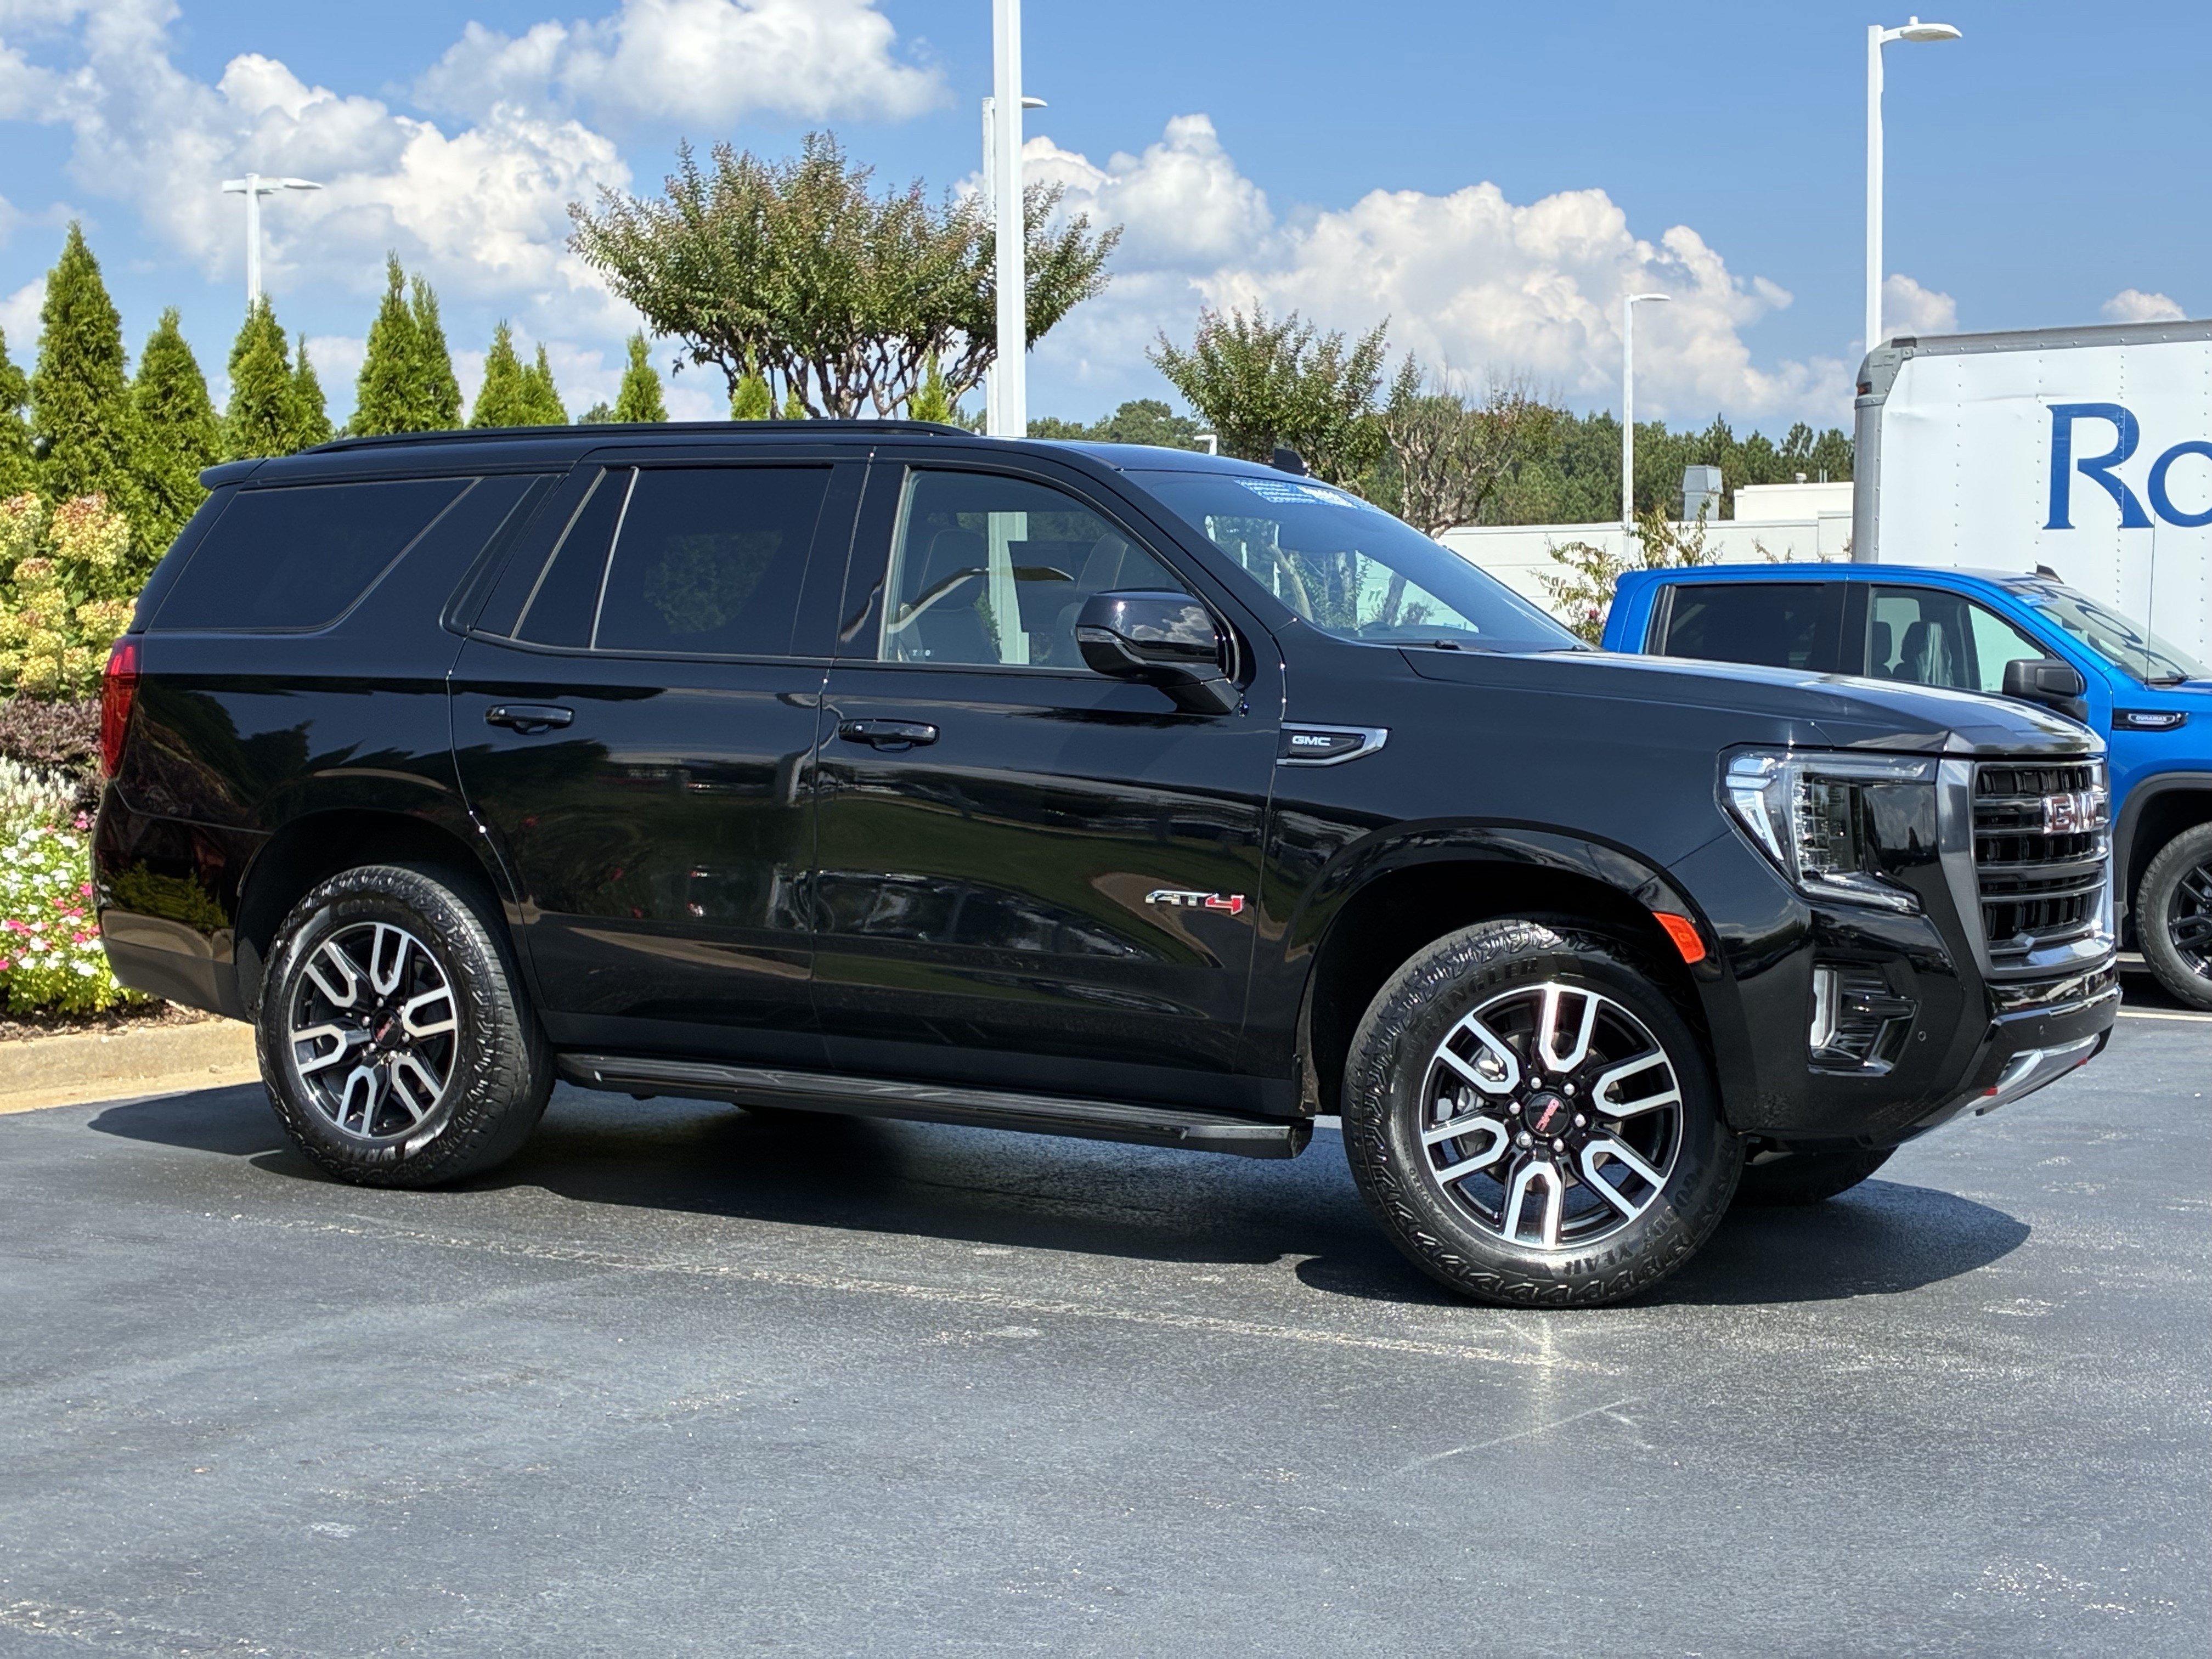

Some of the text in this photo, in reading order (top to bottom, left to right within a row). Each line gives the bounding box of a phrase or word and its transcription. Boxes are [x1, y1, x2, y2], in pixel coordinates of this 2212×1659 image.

[1292, 735, 1331, 747] GMC
[2043, 792, 2111, 834] GMC
[1145, 889, 1245, 916] AT4
[1536, 1098, 1560, 1132] GMC
